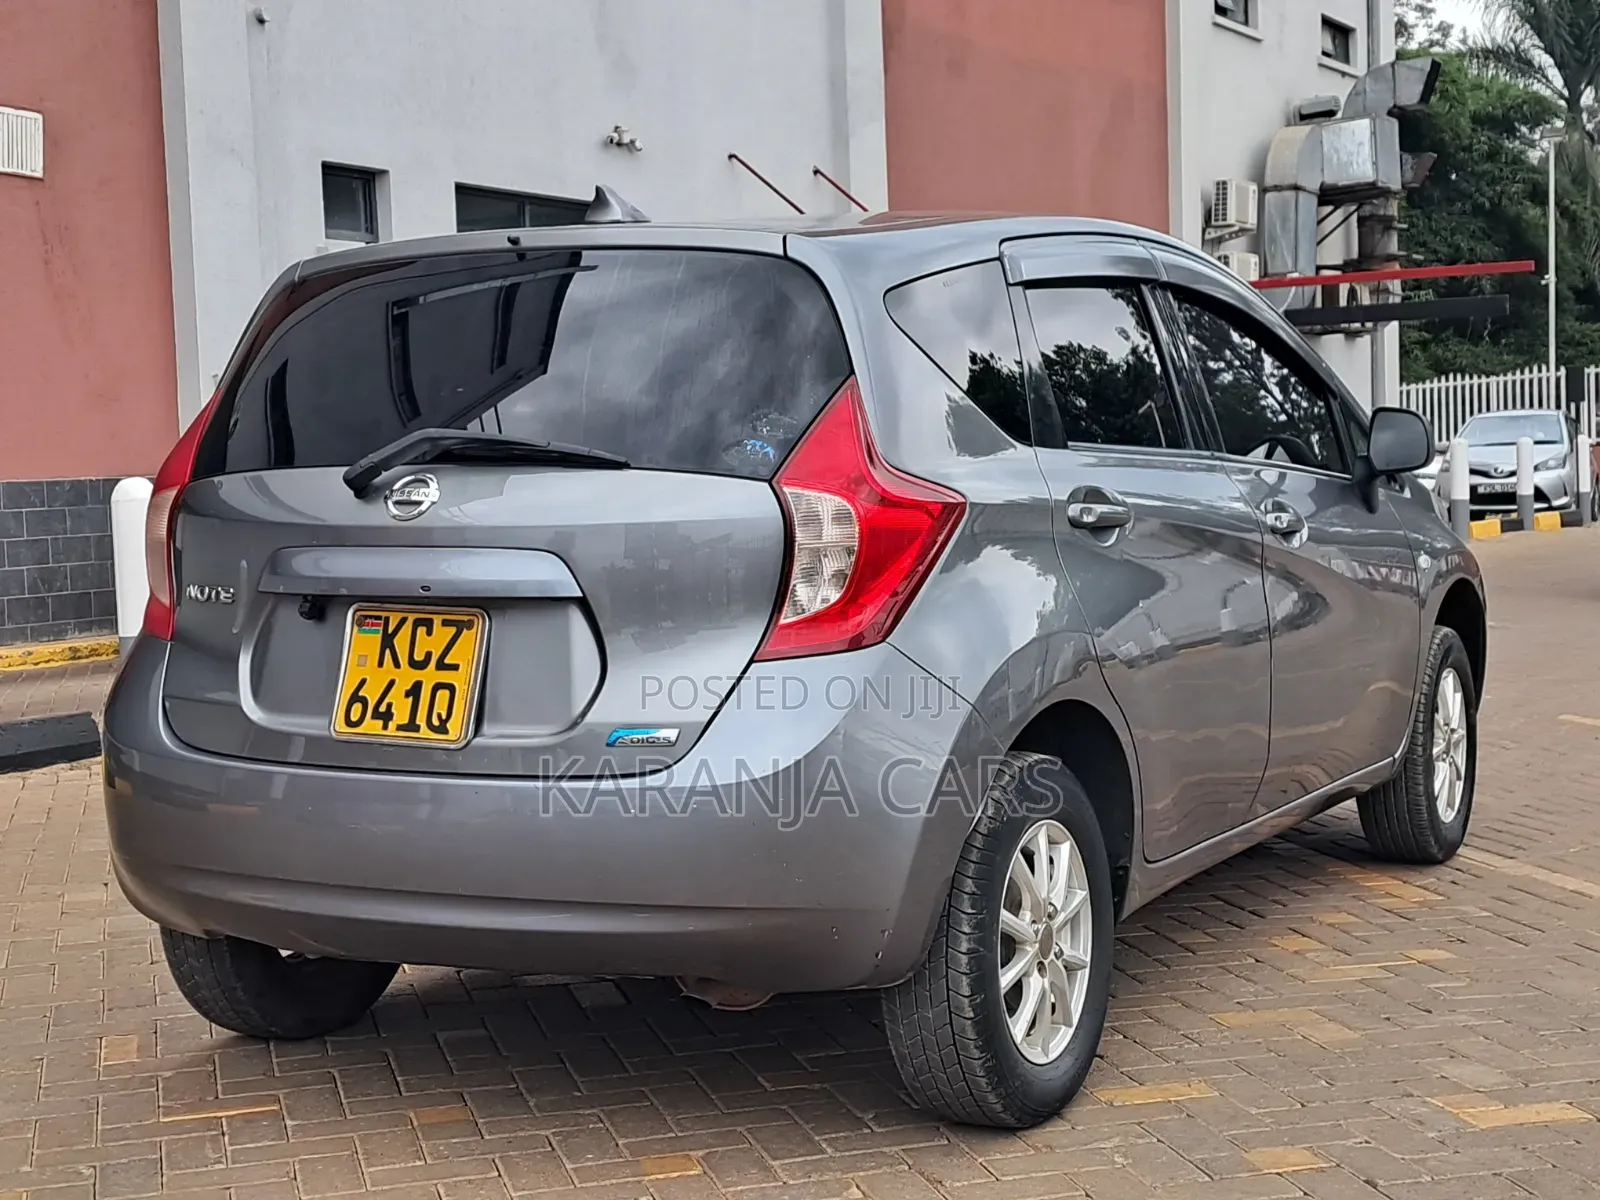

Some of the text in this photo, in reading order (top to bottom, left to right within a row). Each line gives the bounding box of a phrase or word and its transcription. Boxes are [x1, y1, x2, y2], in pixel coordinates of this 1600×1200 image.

[386, 488, 431, 499] NISSAN
[185, 584, 234, 603] NOTE
[377, 616, 473, 671] KCZ
[344, 677, 457, 735] 641Q
